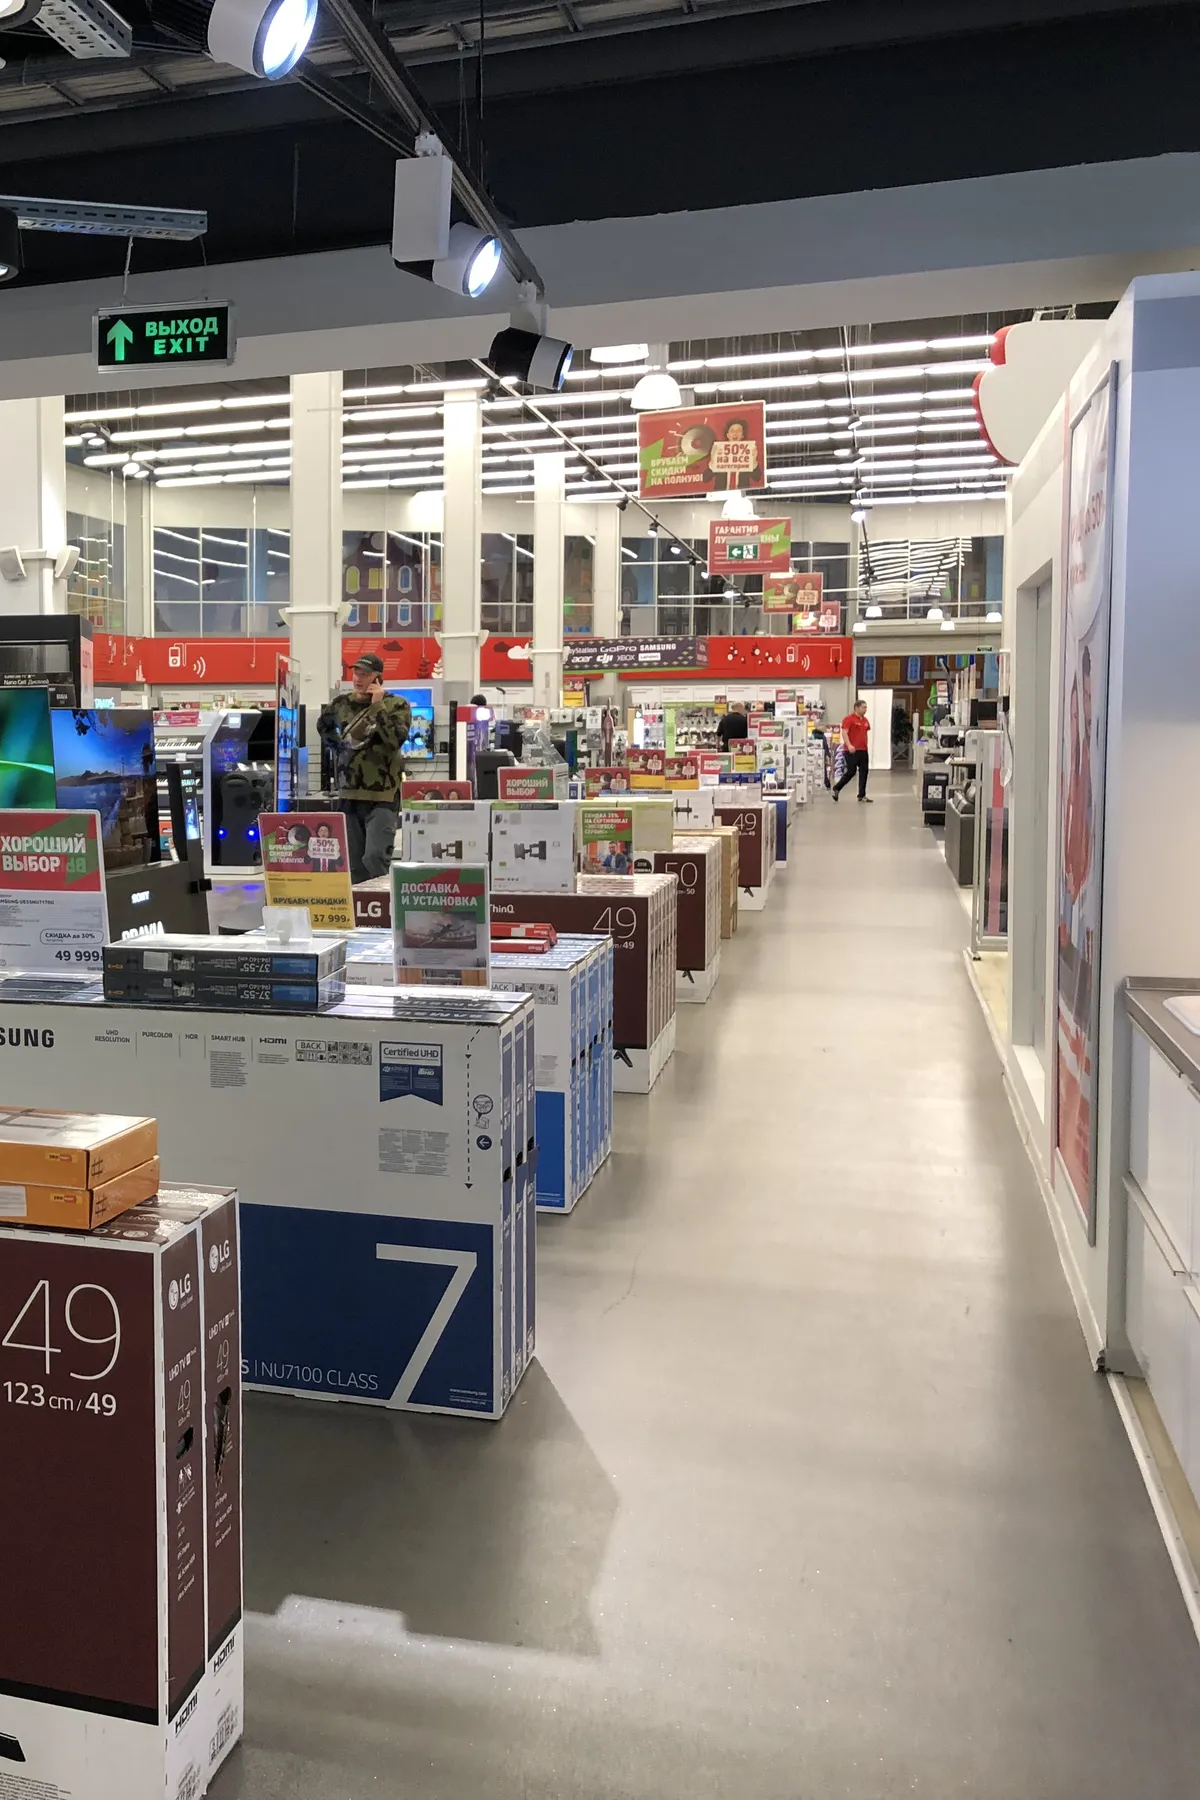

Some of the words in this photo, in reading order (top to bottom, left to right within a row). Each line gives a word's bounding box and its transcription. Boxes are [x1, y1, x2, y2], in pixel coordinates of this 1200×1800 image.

[145, 316, 219, 337] ВЫХОД
[154, 336, 209, 355] EXIT
[651, 457, 689, 466] ВРУБАЕМ
[651, 466, 686, 476] СКИДКИ
[715, 525, 759, 535] ГАРАНТИЯ
[600, 645, 637, 653] GoPro
[640, 643, 676, 651] SAMSUNG
[506, 778, 549, 788] ХОРОШИЙ
[506, 788, 536, 796] ВЫБОР
[733, 812, 756, 830] 49
[0, 833, 86, 853] ХОРОШИЙ
[2, 855, 60, 872] ВЫБОР
[401, 883, 460, 895] ДОСТАВКА
[131, 890, 150, 904] SONY
[273, 897, 309, 905] ВРУБАЕМ
[310, 898, 347, 906] СКИДКИ!
[401, 896, 410, 905] И
[413, 896, 478, 907] УСТАНОВКА
[356, 901, 382, 918] LG
[313, 914, 325, 923] 37
[593, 907, 636, 938] 49
[623, 941, 635, 949] 49
[55, 950, 71, 961] 49
[74, 951, 100, 962] 999
[94, 1035, 131, 1044] RESOLUTION
[142, 1031, 173, 1039] PURCOLOR
[231, 1035, 246, 1043] HUB
[259, 1036, 287, 1045] HDMI
[300, 1041, 322, 1050] BACK
[383, 1047, 419, 1057] Certified
[420, 1049, 439, 1058] UHD
[219, 1239, 230, 1263] LG
[179, 1273, 191, 1299] LG
[376, 1242, 477, 1403] 7
[2, 1279, 121, 1381] 49
[216, 1339, 229, 1371] 49
[261, 1361, 323, 1385] NU7100
[326, 1369, 379, 1391] CLASS
[3, 1381, 45, 1407] 123
[49, 1394, 74, 1411] cm
[85, 1392, 117, 1417] 49
[177, 1379, 191, 1413] 49
[214, 1635, 235, 1674] HDMI
[175, 1691, 198, 1735] HDMI
